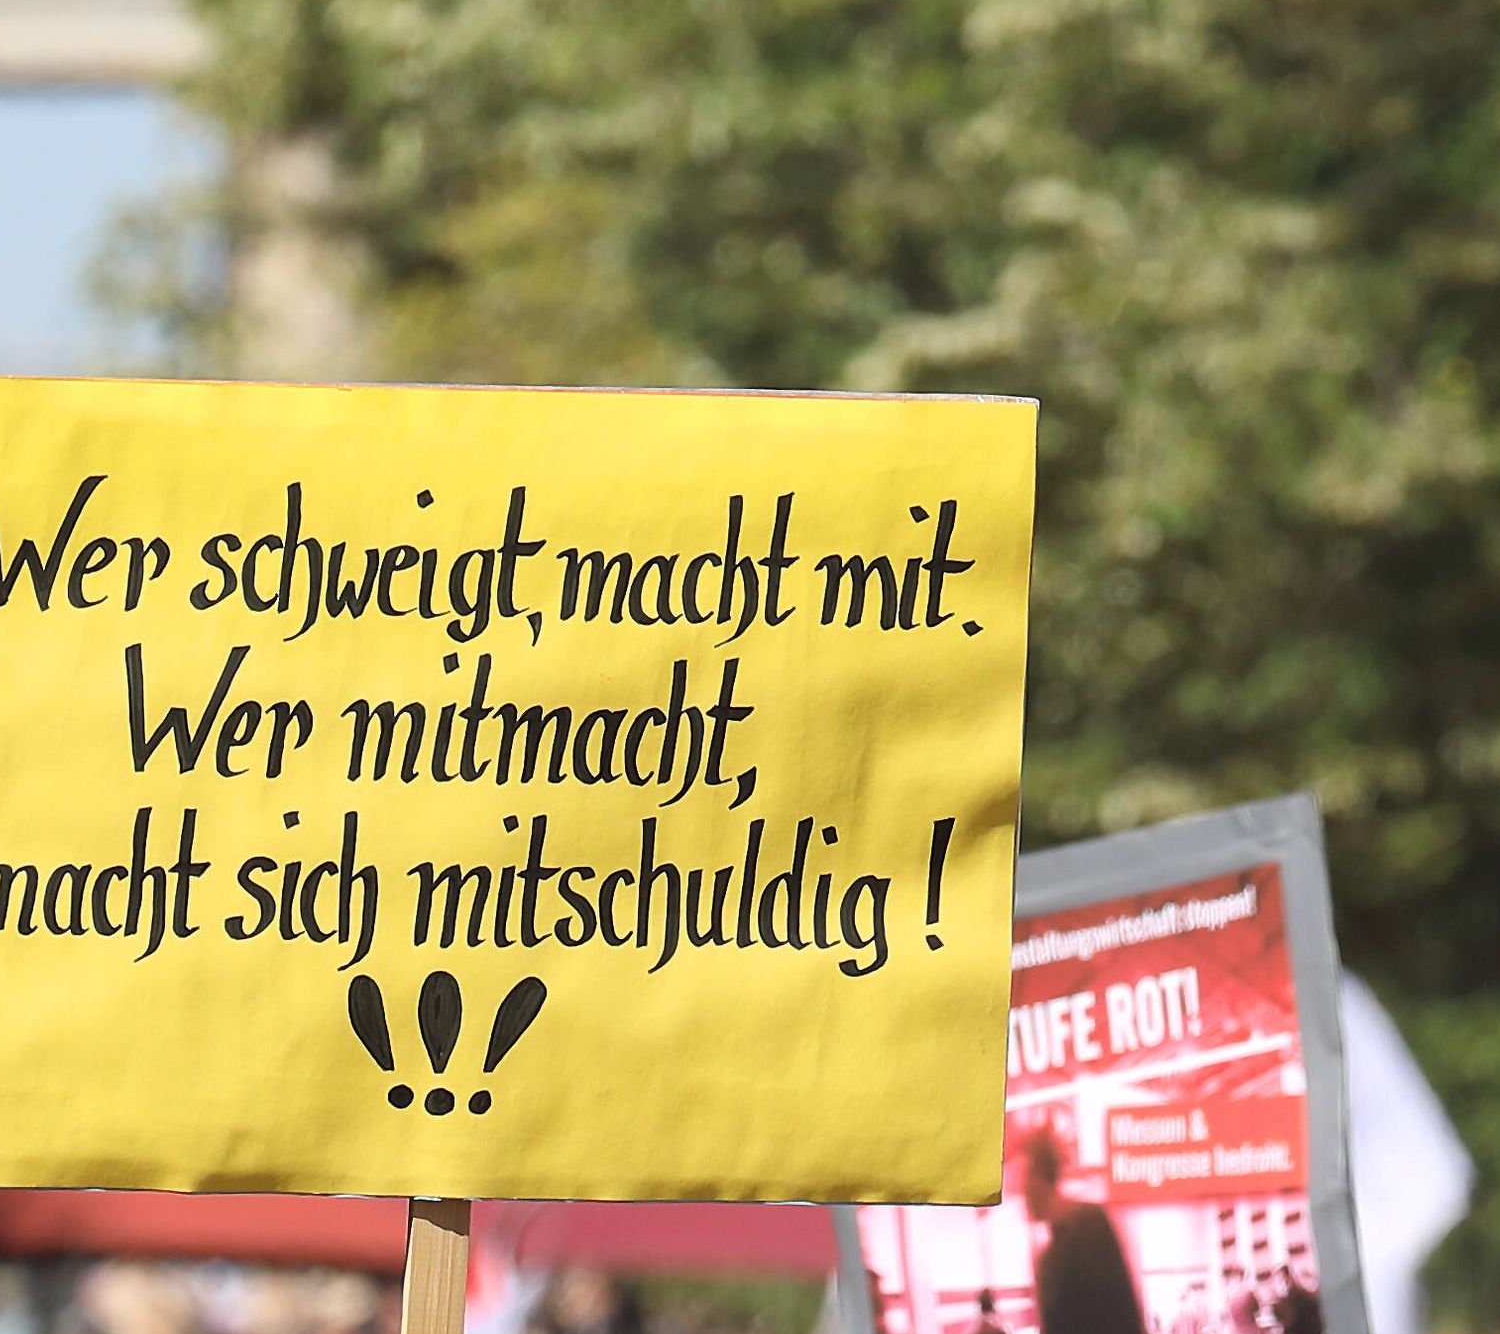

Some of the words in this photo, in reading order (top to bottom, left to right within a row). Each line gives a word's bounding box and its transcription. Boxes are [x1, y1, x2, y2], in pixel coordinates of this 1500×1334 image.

[190, 482, 546, 646] schweigt,
[557, 492, 799, 647] macht
[814, 500, 983, 636] mit.
[125, 644, 313, 781] Wer
[341, 653, 756, 810] mitmacht,
[225, 811, 378, 971] sich
[407, 816, 891, 977] mitschuldig
[1105, 966, 1202, 1054] ROT!
